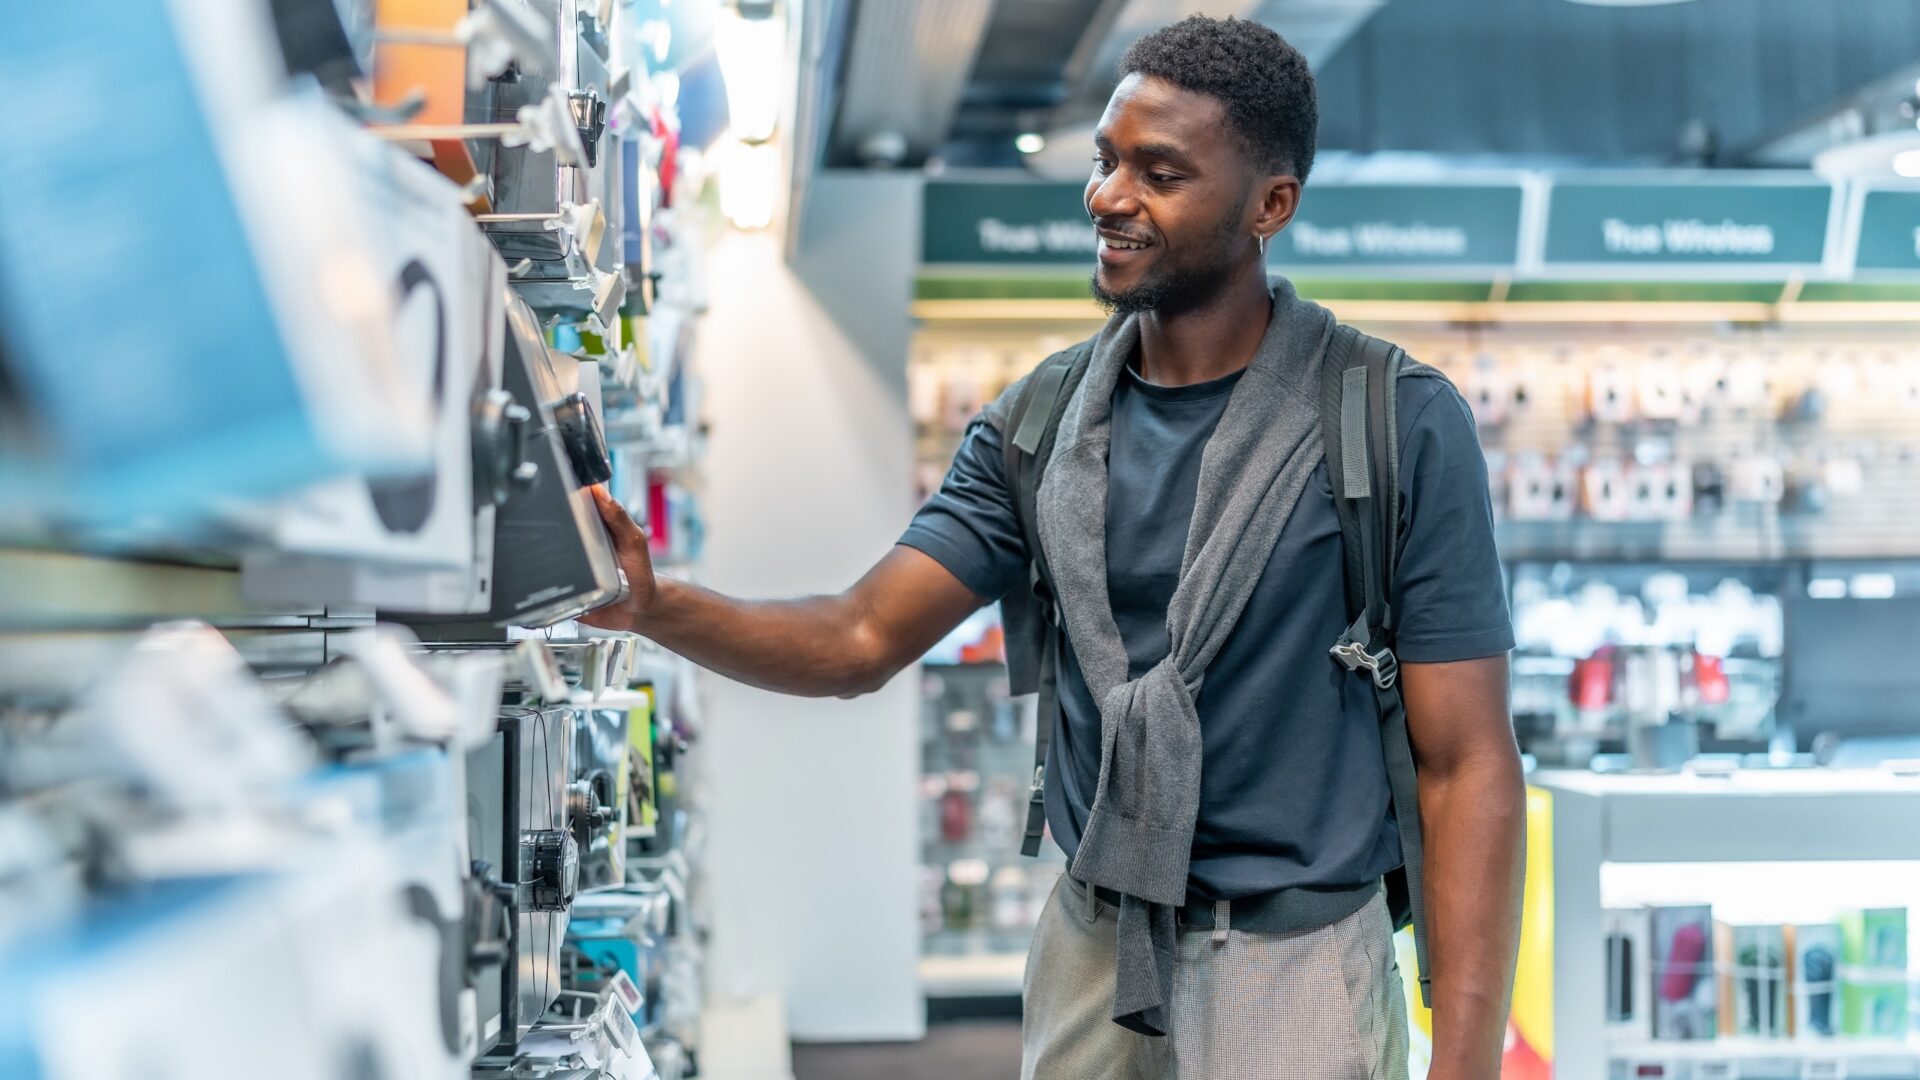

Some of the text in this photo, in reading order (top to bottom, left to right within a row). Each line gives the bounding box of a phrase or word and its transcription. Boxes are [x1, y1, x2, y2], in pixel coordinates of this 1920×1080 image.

[978, 219, 1039, 252] True
[1292, 221, 1466, 255] True Wireless
[1602, 218, 1774, 254] True Wireless
